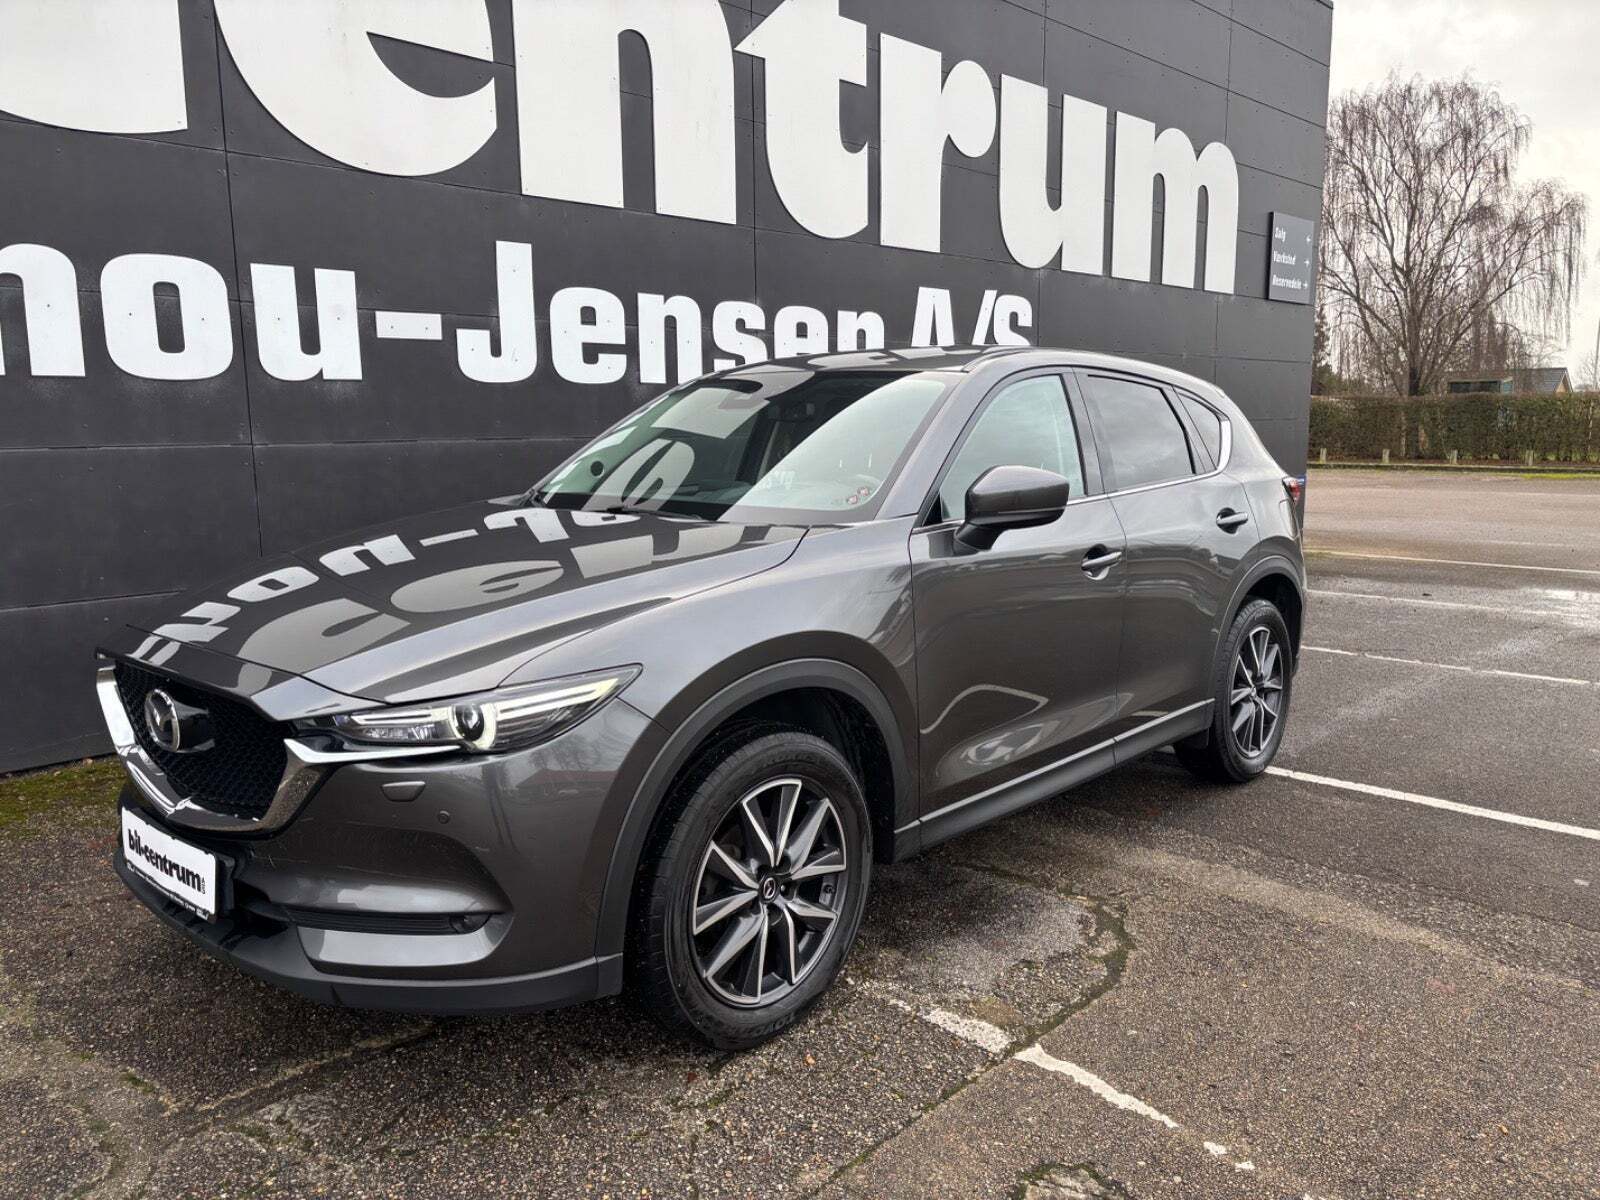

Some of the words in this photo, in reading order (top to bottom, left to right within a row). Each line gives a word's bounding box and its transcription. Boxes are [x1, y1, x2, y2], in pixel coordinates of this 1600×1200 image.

[0, 0, 1240, 294] entrum
[911, 286, 1033, 347] A/S
[128, 828, 201, 893] bil-centrum
